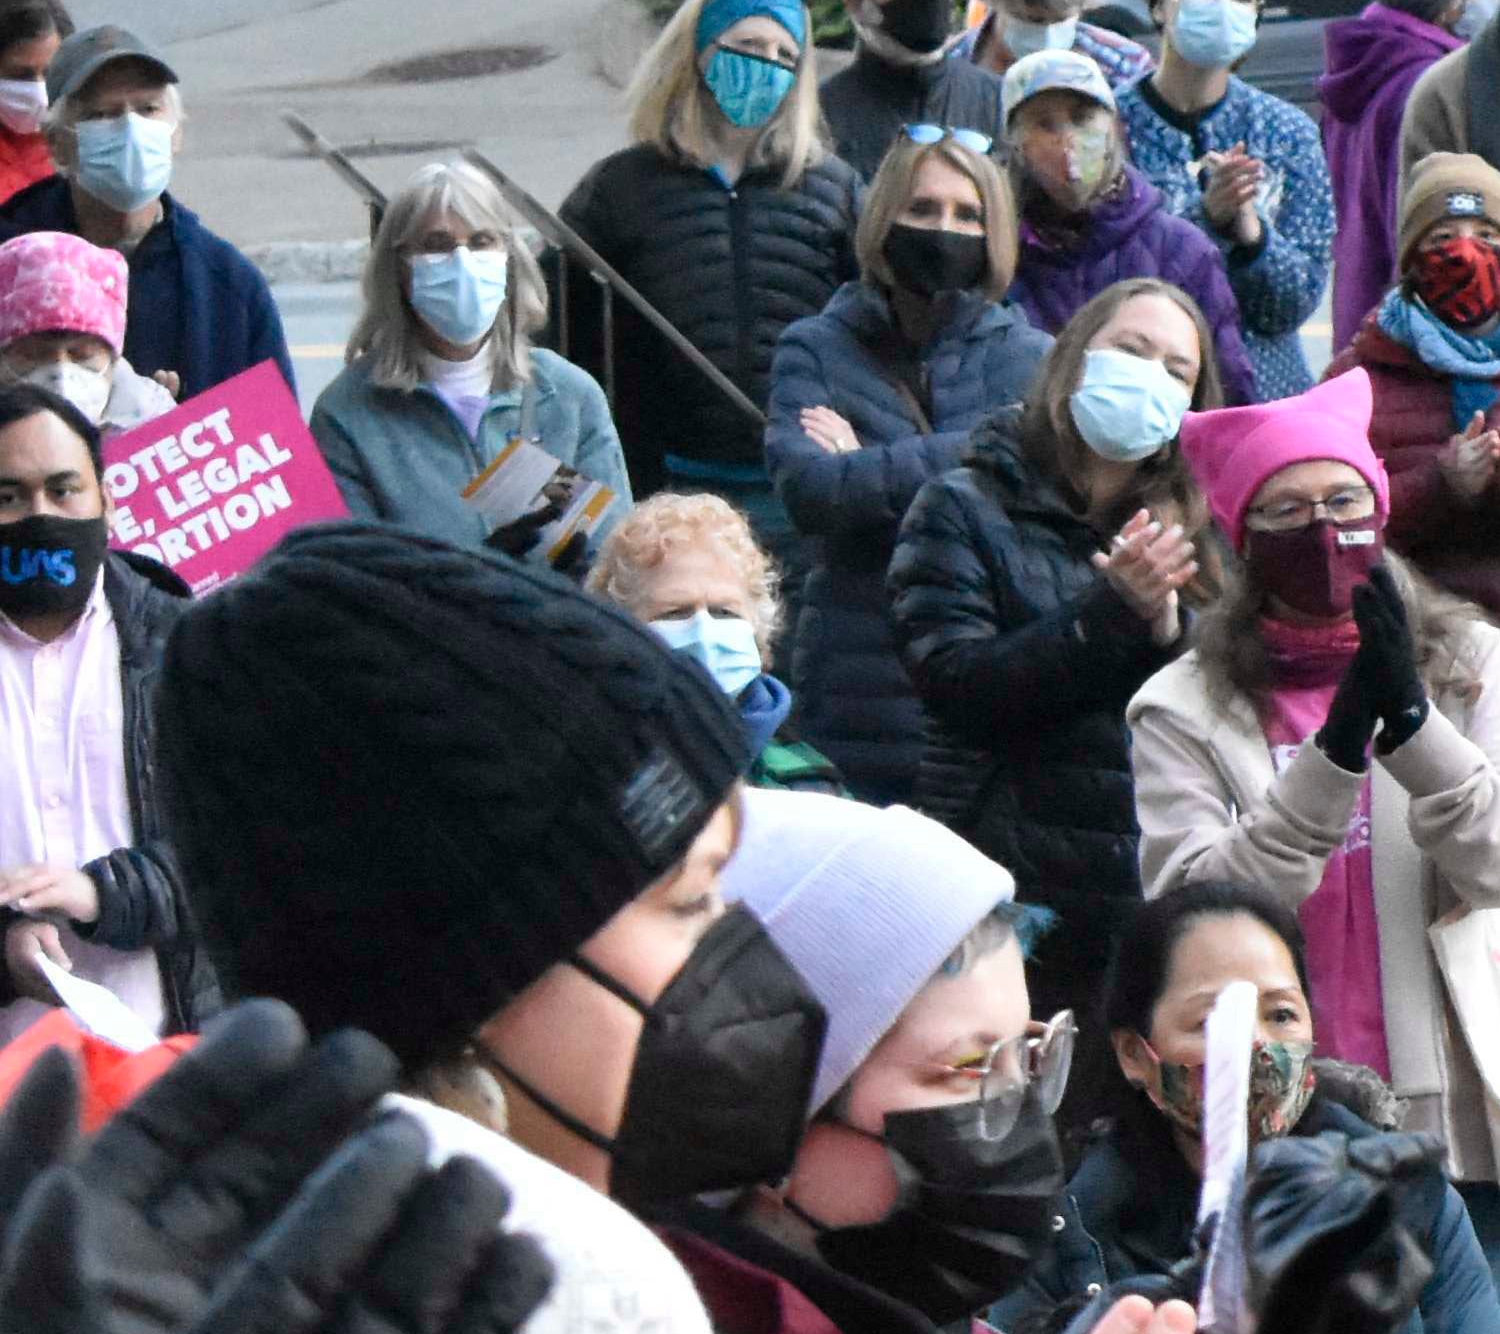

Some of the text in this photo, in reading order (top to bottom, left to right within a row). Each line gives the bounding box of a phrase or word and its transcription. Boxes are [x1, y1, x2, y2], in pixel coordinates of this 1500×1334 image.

[103, 408, 235, 500] OTECT
[155, 432, 293, 519] LEGAL
[131, 474, 293, 567] ORTION
